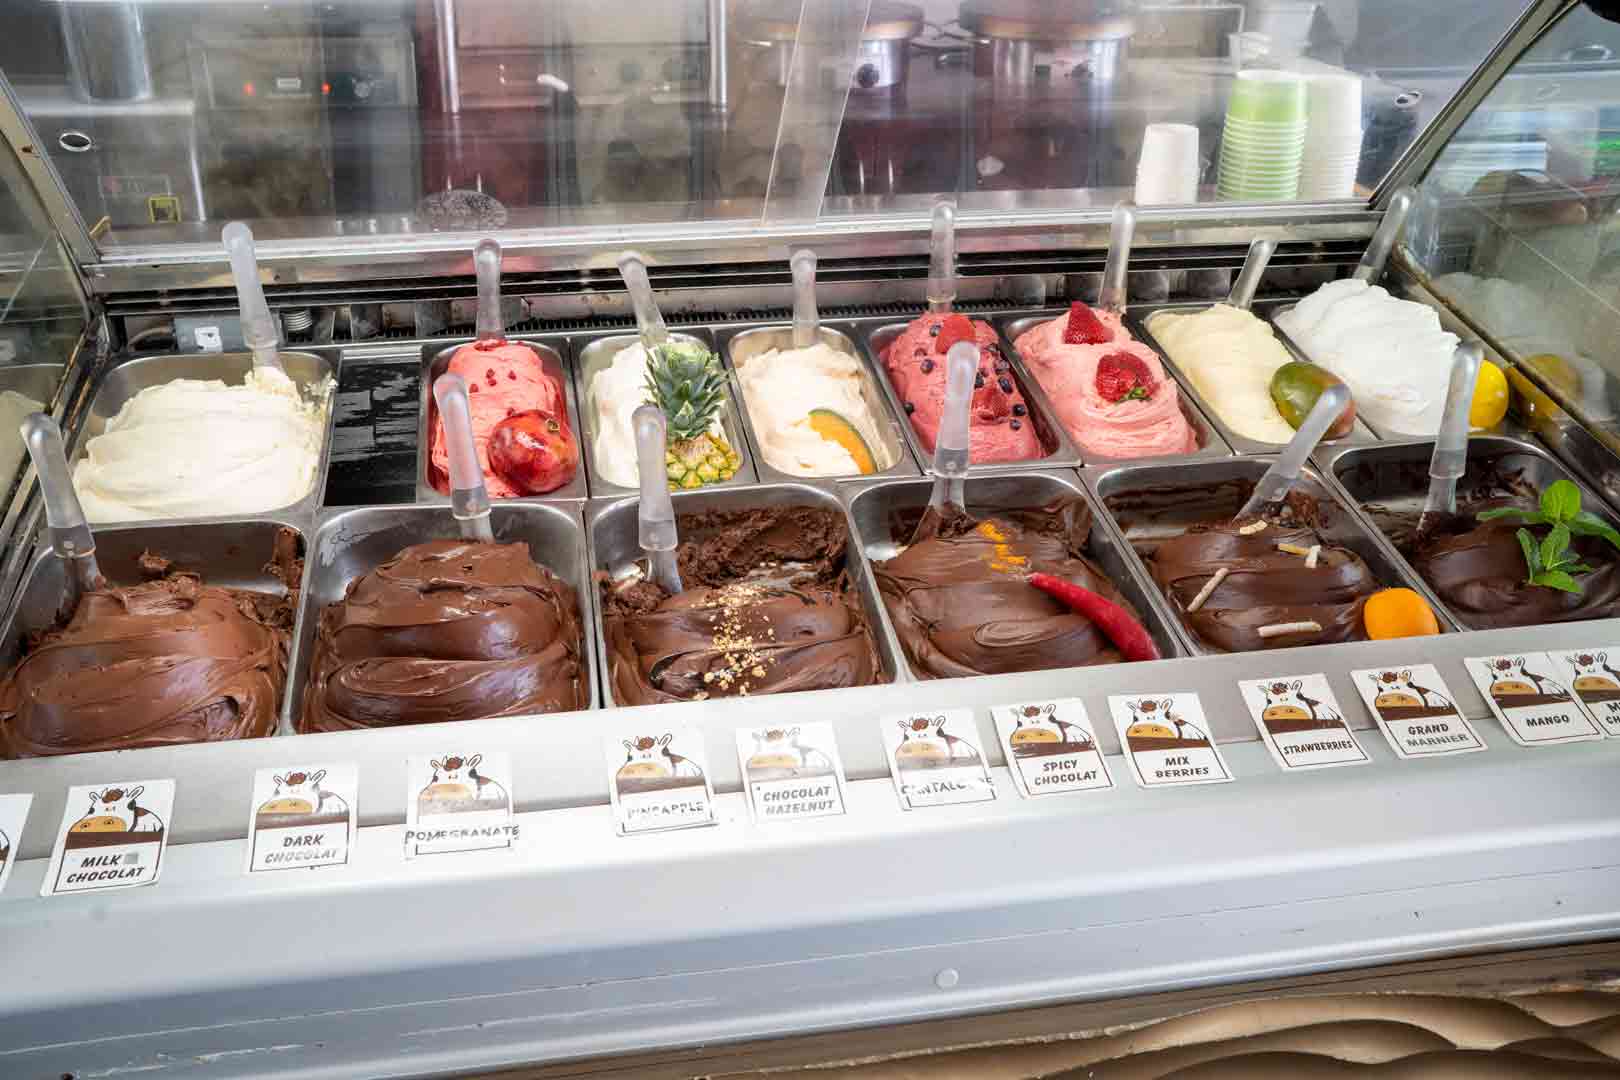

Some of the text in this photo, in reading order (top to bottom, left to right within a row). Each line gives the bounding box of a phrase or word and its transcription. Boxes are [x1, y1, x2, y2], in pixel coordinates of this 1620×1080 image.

[1526, 714, 1570, 729] MANGO
[1408, 723, 1449, 736] GRAND
[1284, 741, 1353, 755] STRAWBERRIES
[1406, 735, 1469, 748] MARNIER
[1043, 760, 1078, 773] SPICY
[1164, 756, 1190, 767] MIX
[1034, 771, 1098, 787] CHOCOLAT
[1155, 767, 1209, 778] BERRIES
[900, 776, 993, 794] CNTALE
[763, 785, 832, 802] CHOCOLAT
[766, 799, 835, 815] HAZELNUT
[283, 834, 324, 848] DARK
[404, 824, 520, 845] POMEGRANATE
[80, 855, 120, 868] MILK
[264, 848, 337, 864] CHOCOLAT
[66, 867, 145, 884] CHOCOLAT
